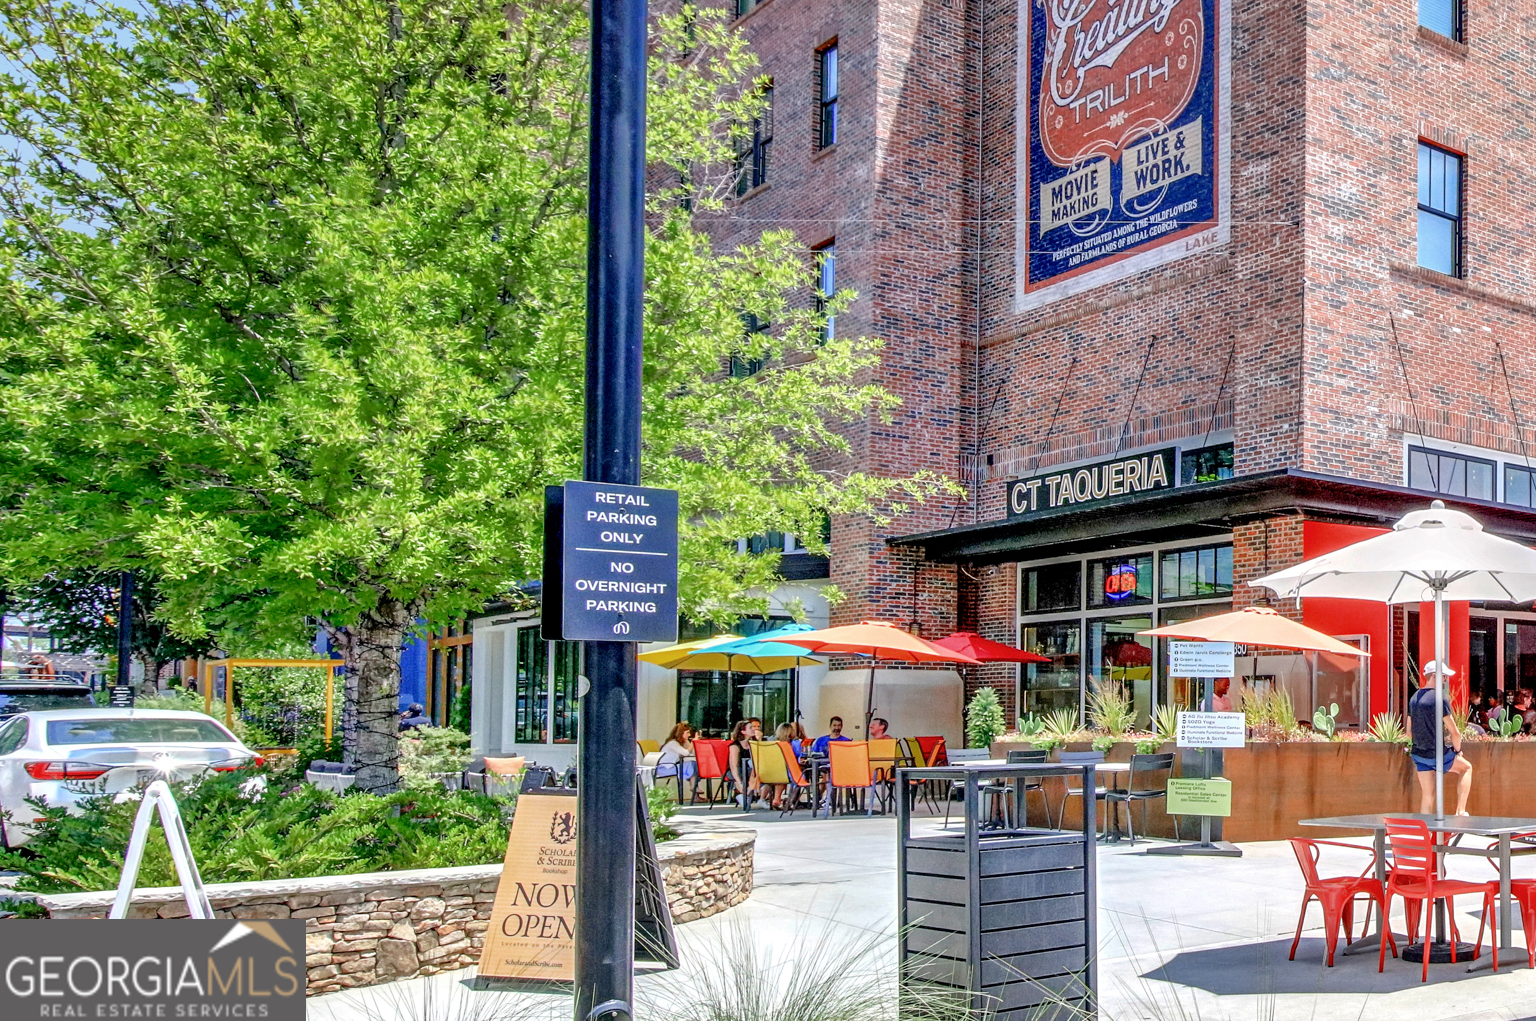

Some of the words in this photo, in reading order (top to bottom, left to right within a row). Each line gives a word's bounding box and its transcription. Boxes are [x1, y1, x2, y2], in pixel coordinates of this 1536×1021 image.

[1070, 56, 1169, 124] TRILITH
[1136, 136, 1169, 167] LIVE
[1174, 131, 1186, 150] &
[1134, 152, 1190, 191] WORK.
[1052, 169, 1099, 207] MOVIE
[1051, 192, 1098, 224] MAKING
[1052, 243, 1083, 262] PERFECTLY
[1084, 231, 1112, 250] SITUATED
[1113, 224, 1135, 240] AMONG
[1136, 219, 1149, 230] THE
[1149, 199, 1198, 224] WILDFLOWERS
[1185, 231, 1218, 252] LAKE
[1068, 256, 1081, 267] AND
[1081, 241, 1117, 263] FARMLANDS
[1118, 238, 1126, 249] OF
[1127, 231, 1149, 245] RURAL
[1149, 219, 1178, 236] GEORGIA
[1011, 480, 1041, 514] CT
[1045, 453, 1168, 507] TAQUERIA
[596, 492, 650, 506] RETAIL
[587, 511, 657, 526] PARKING
[600, 531, 643, 544] ONLY
[610, 562, 634, 574] NO
[575, 580, 667, 594] OVERNIGHT
[586, 600, 657, 613] PARKING
[537, 857, 545, 865] &
[542, 867, 568, 875] Bookshop
[502, 913, 576, 940] OPEN
